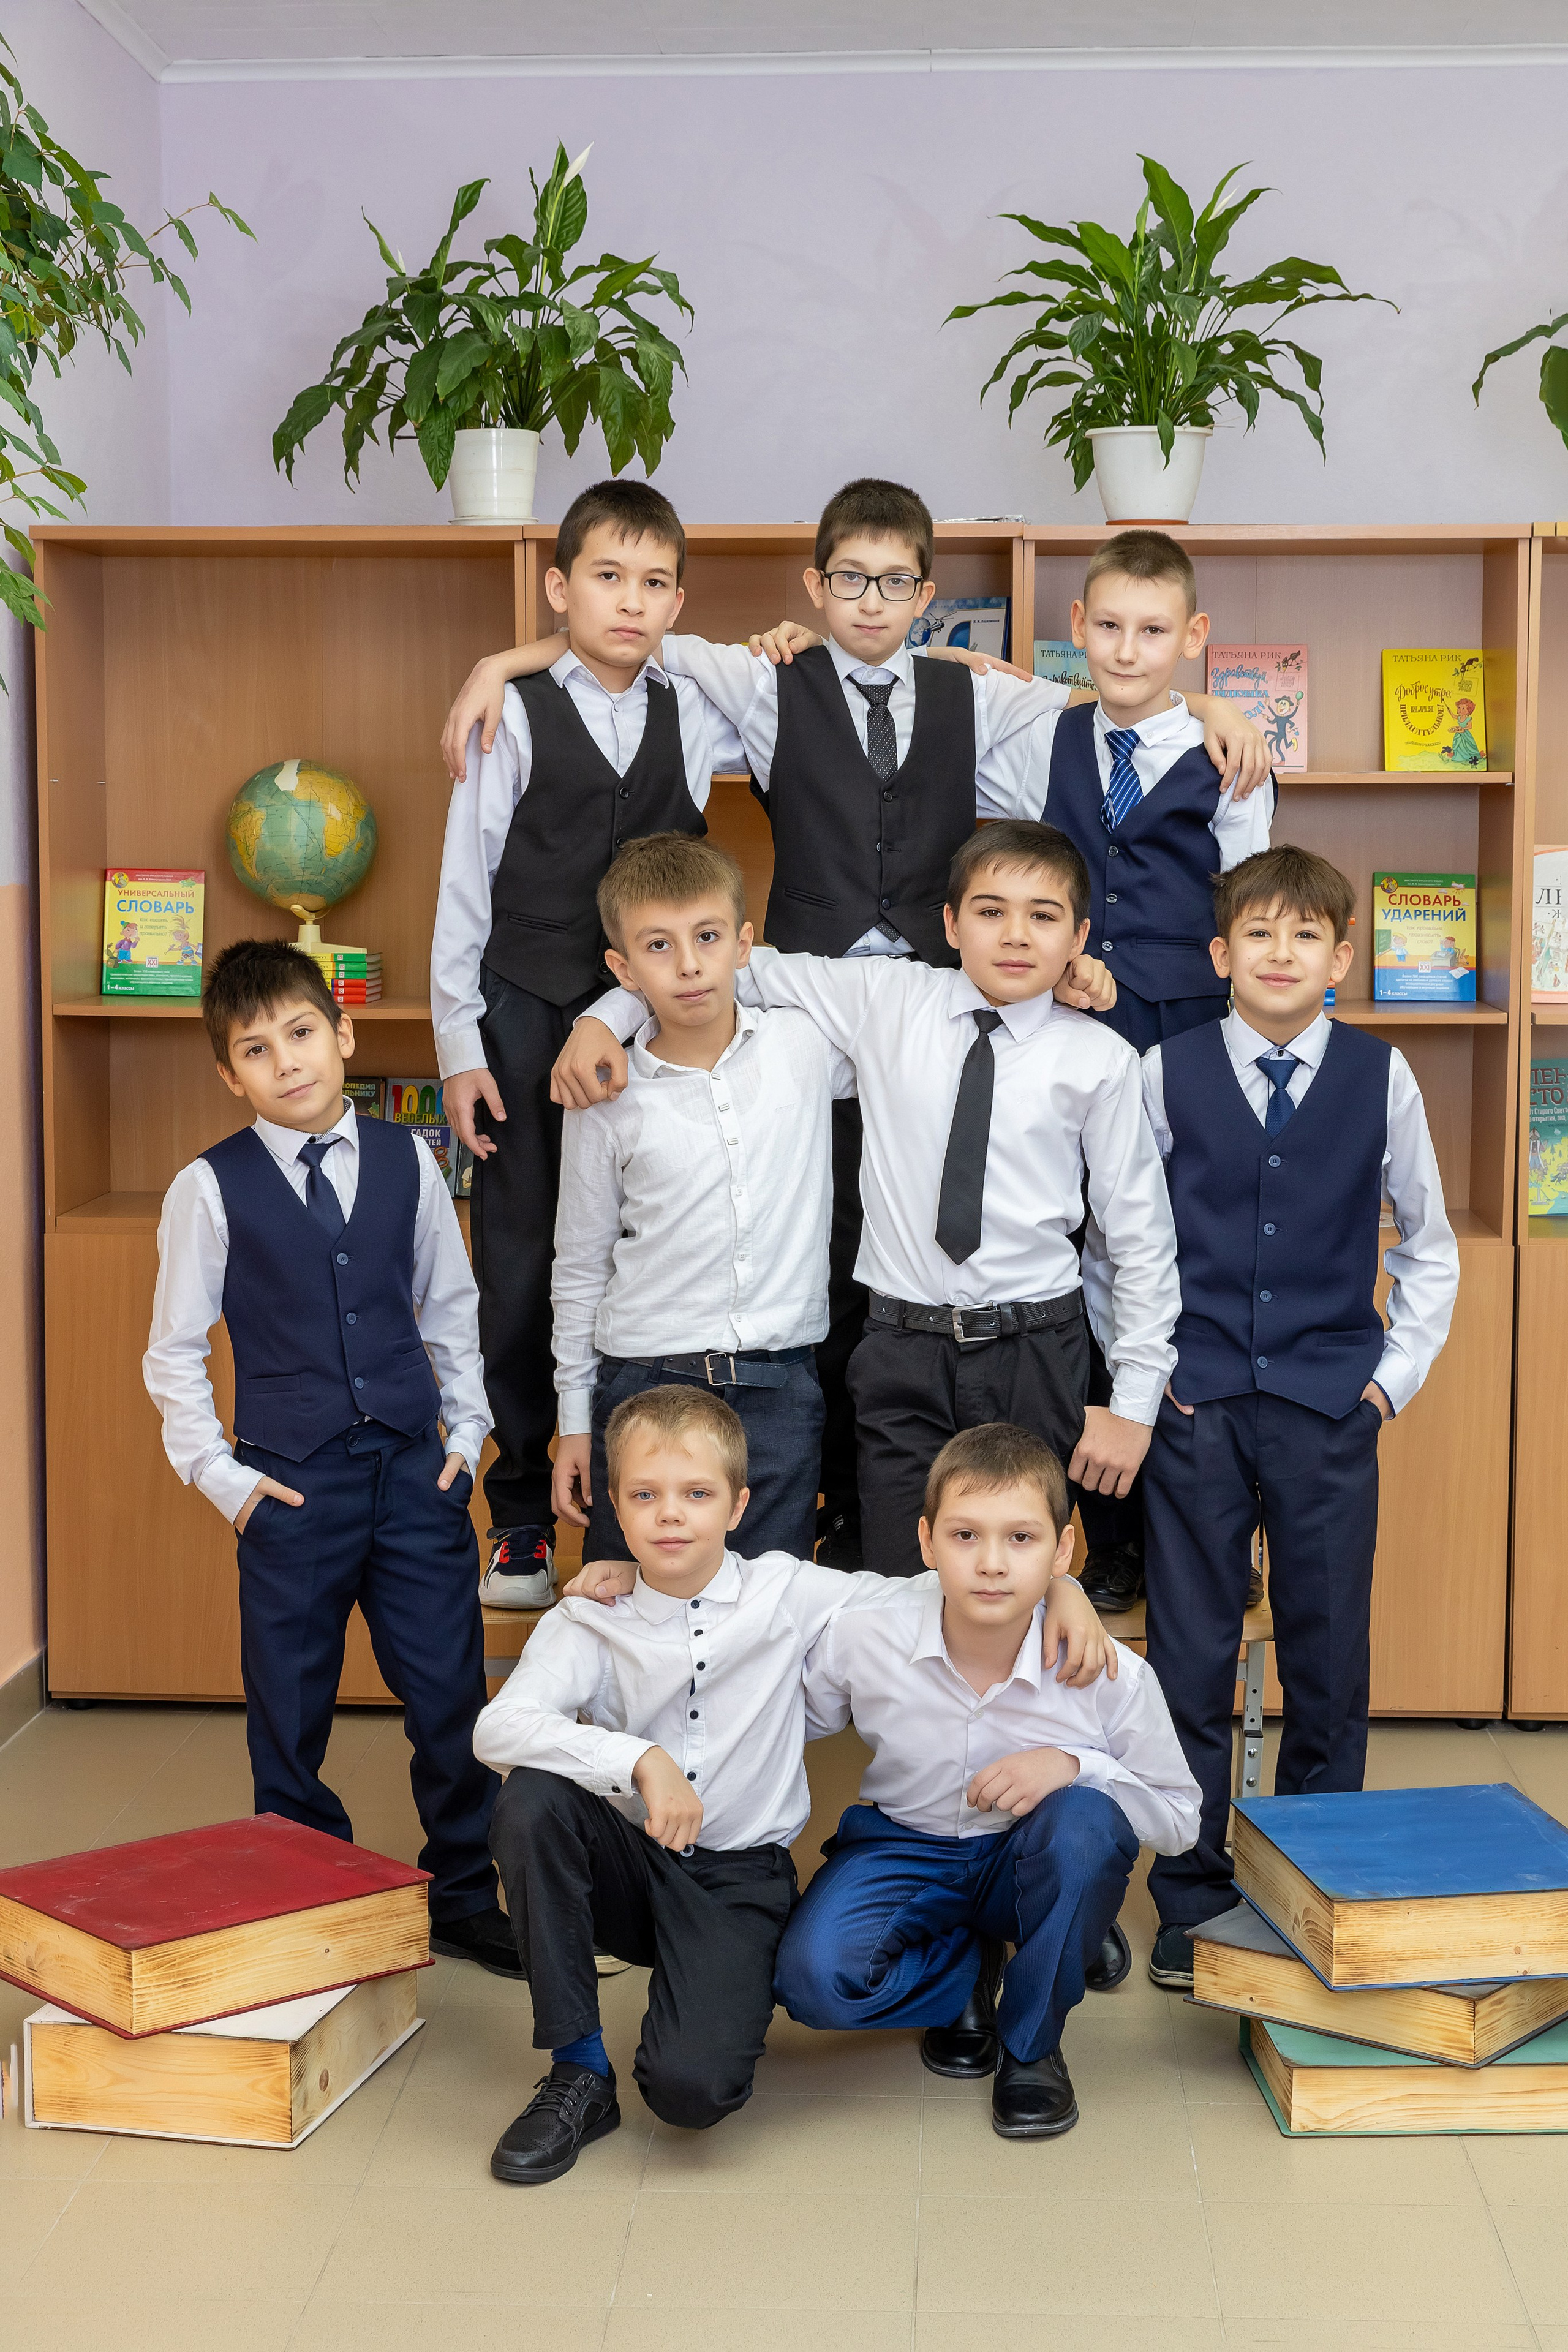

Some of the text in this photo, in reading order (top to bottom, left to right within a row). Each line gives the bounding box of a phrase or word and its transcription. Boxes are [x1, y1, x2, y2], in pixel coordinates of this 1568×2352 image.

[1041, 650, 1077, 658] ТАТЬЯНА
[1395, 680, 1428, 702] Доброе
[118, 889, 194, 898] УНИВЕРСАЛЬНЫЙ
[116, 899, 195, 914] СЛОВАРЬ
[1388, 894, 1461, 907] СЛОВАРЬ
[1382, 908, 1466, 922] УДАРЕНИЙ
[394, 1112, 447, 1125] ВЕСЕЛЫХ
